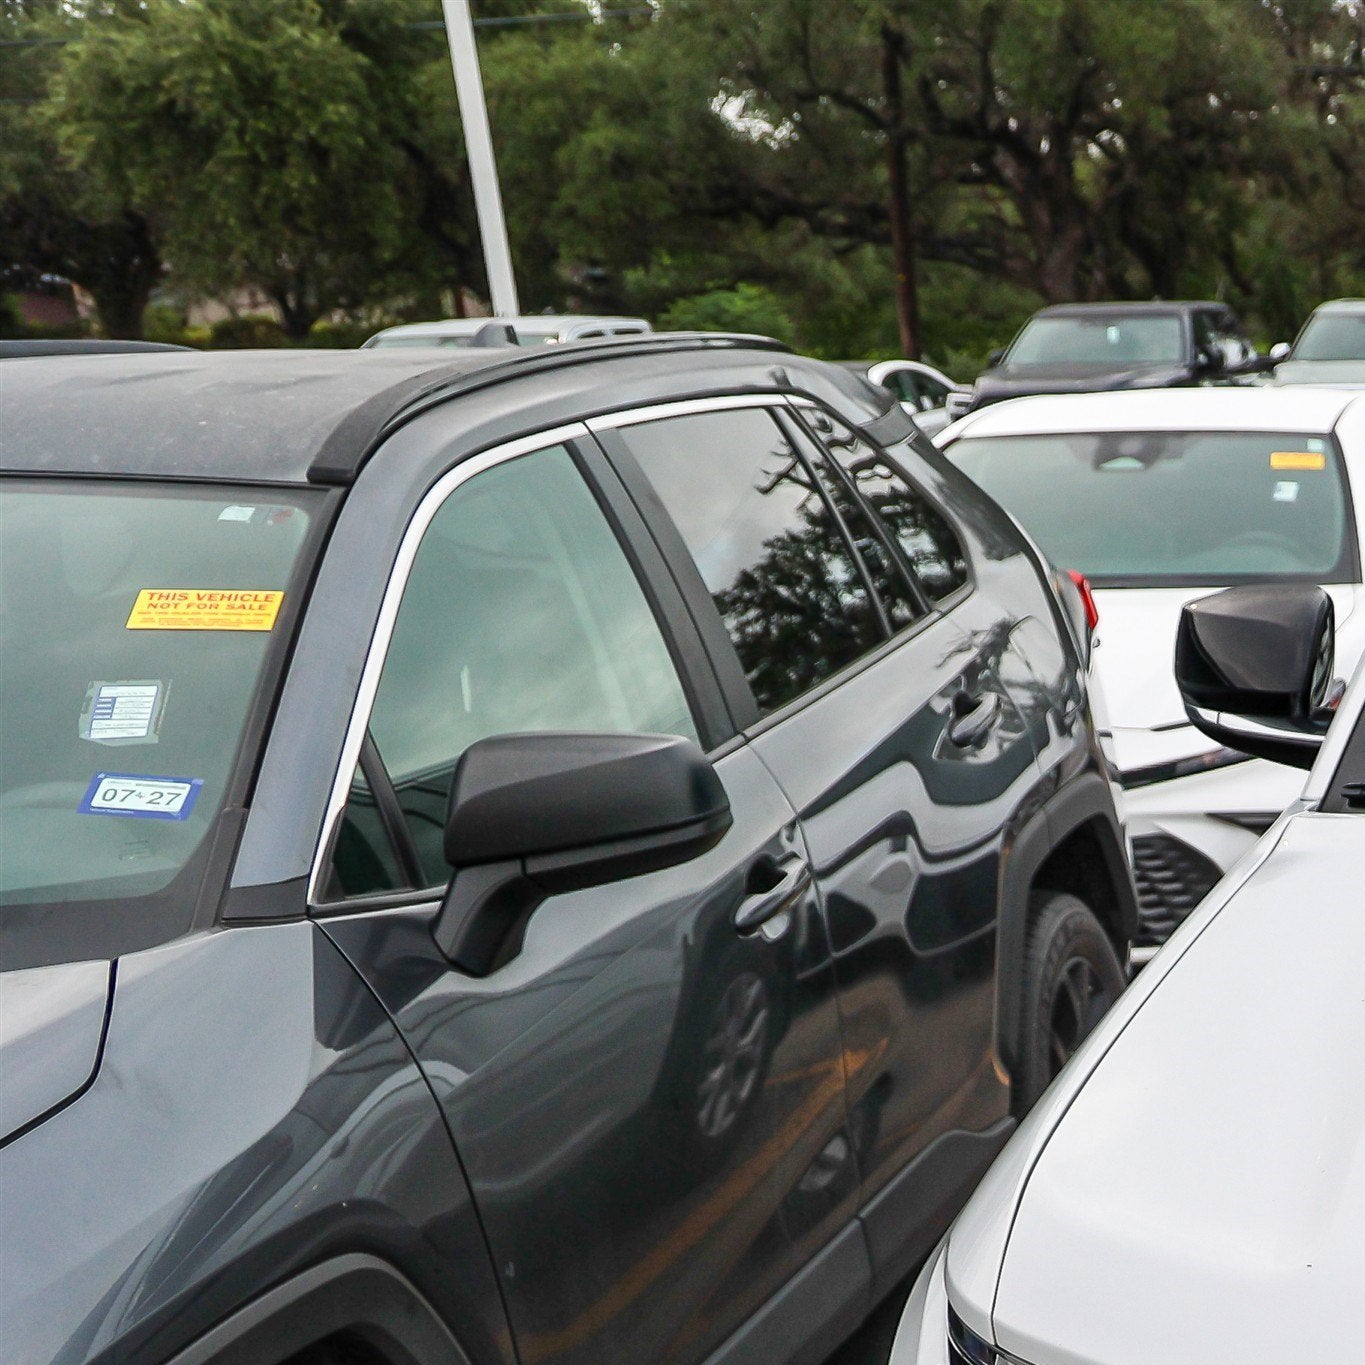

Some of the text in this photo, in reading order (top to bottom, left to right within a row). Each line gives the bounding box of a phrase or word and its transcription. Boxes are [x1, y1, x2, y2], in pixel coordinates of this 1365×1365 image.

[147, 592, 275, 603] THIS VEHICLE
[147, 602, 179, 610] NOT
[226, 603, 268, 611] SALE
[102, 788, 182, 806] 07 27
